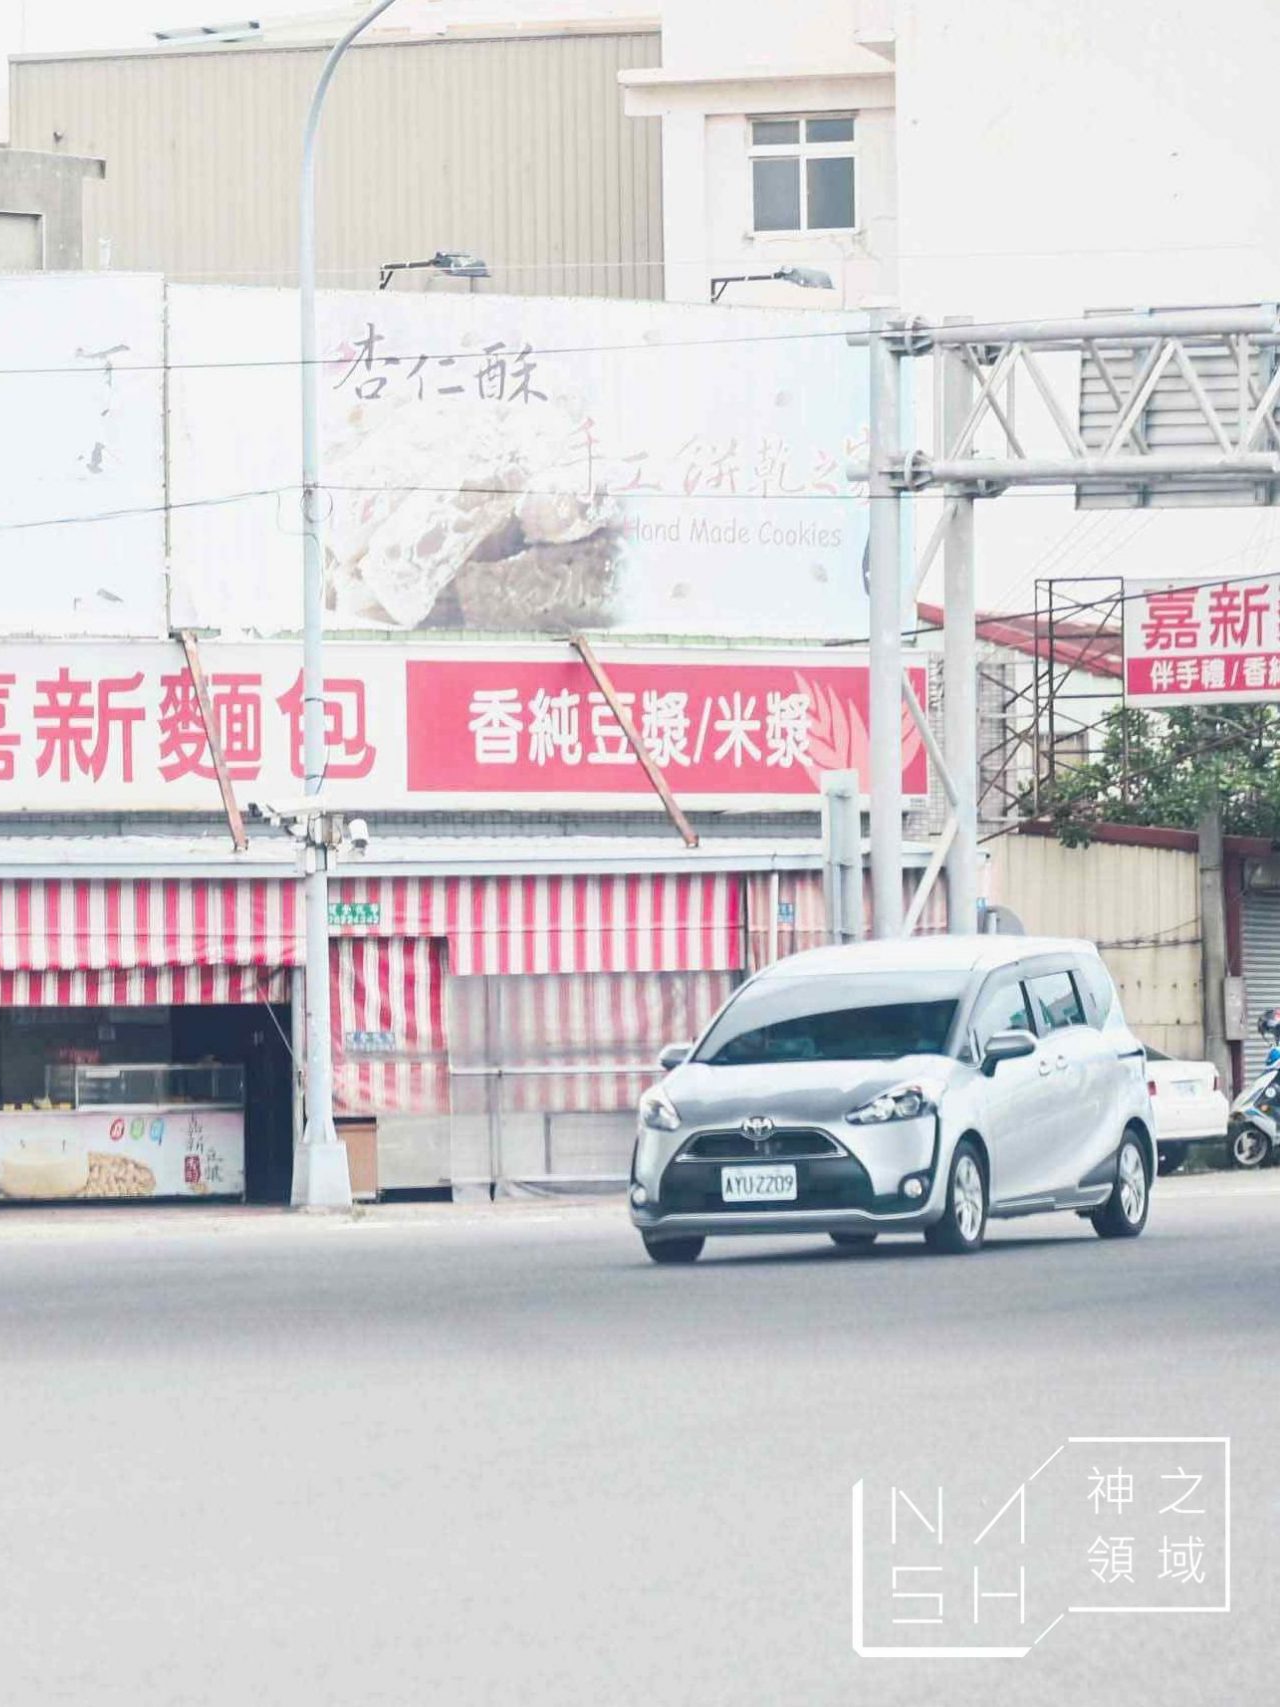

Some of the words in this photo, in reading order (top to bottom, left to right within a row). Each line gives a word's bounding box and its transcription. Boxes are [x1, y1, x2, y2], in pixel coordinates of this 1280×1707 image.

[333, 322, 549, 405] 杏仁酥
[623, 512, 681, 542] Hand
[689, 515, 751, 544] Made
[757, 519, 843, 548] Cookies
[1141, 582, 1280, 651] 嘉新
[468, 687, 815, 768] 香純豆漿/米漿
